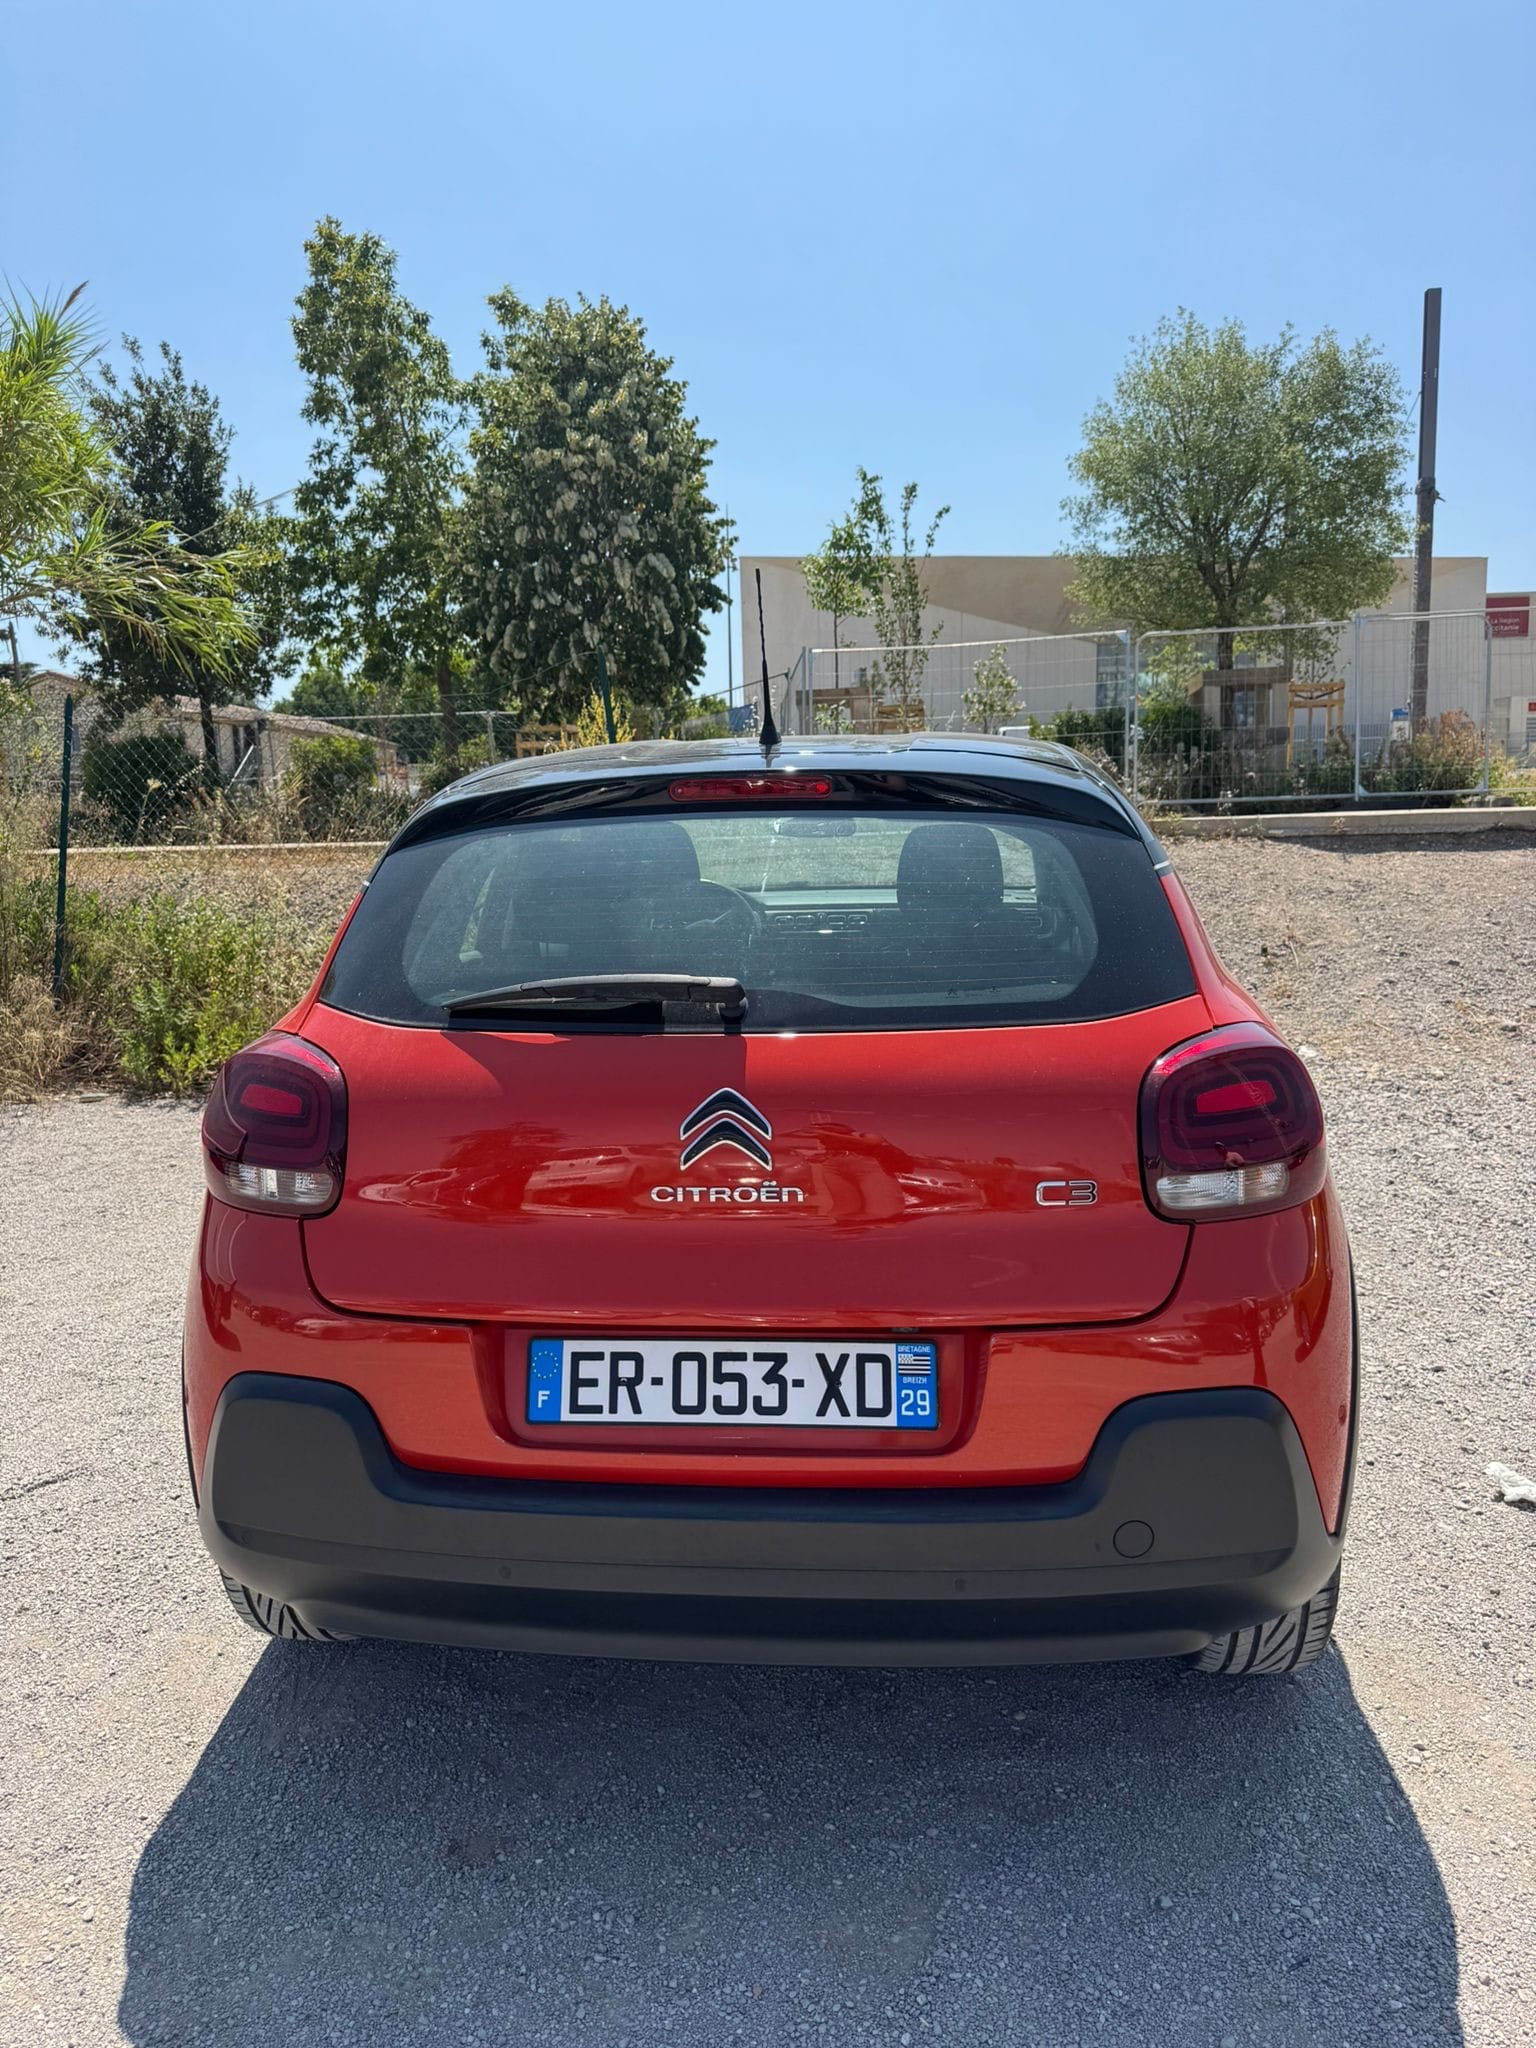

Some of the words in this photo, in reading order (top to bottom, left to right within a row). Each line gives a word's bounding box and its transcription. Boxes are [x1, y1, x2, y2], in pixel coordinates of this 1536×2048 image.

[1036, 1180, 1098, 1206] C3
[897, 1345, 930, 1353] BRETAGNE
[569, 1351, 892, 1418] ER-053-XD
[902, 1376, 928, 1384] BREIZH
[537, 1390, 550, 1409] F
[901, 1389, 931, 1416] 29
